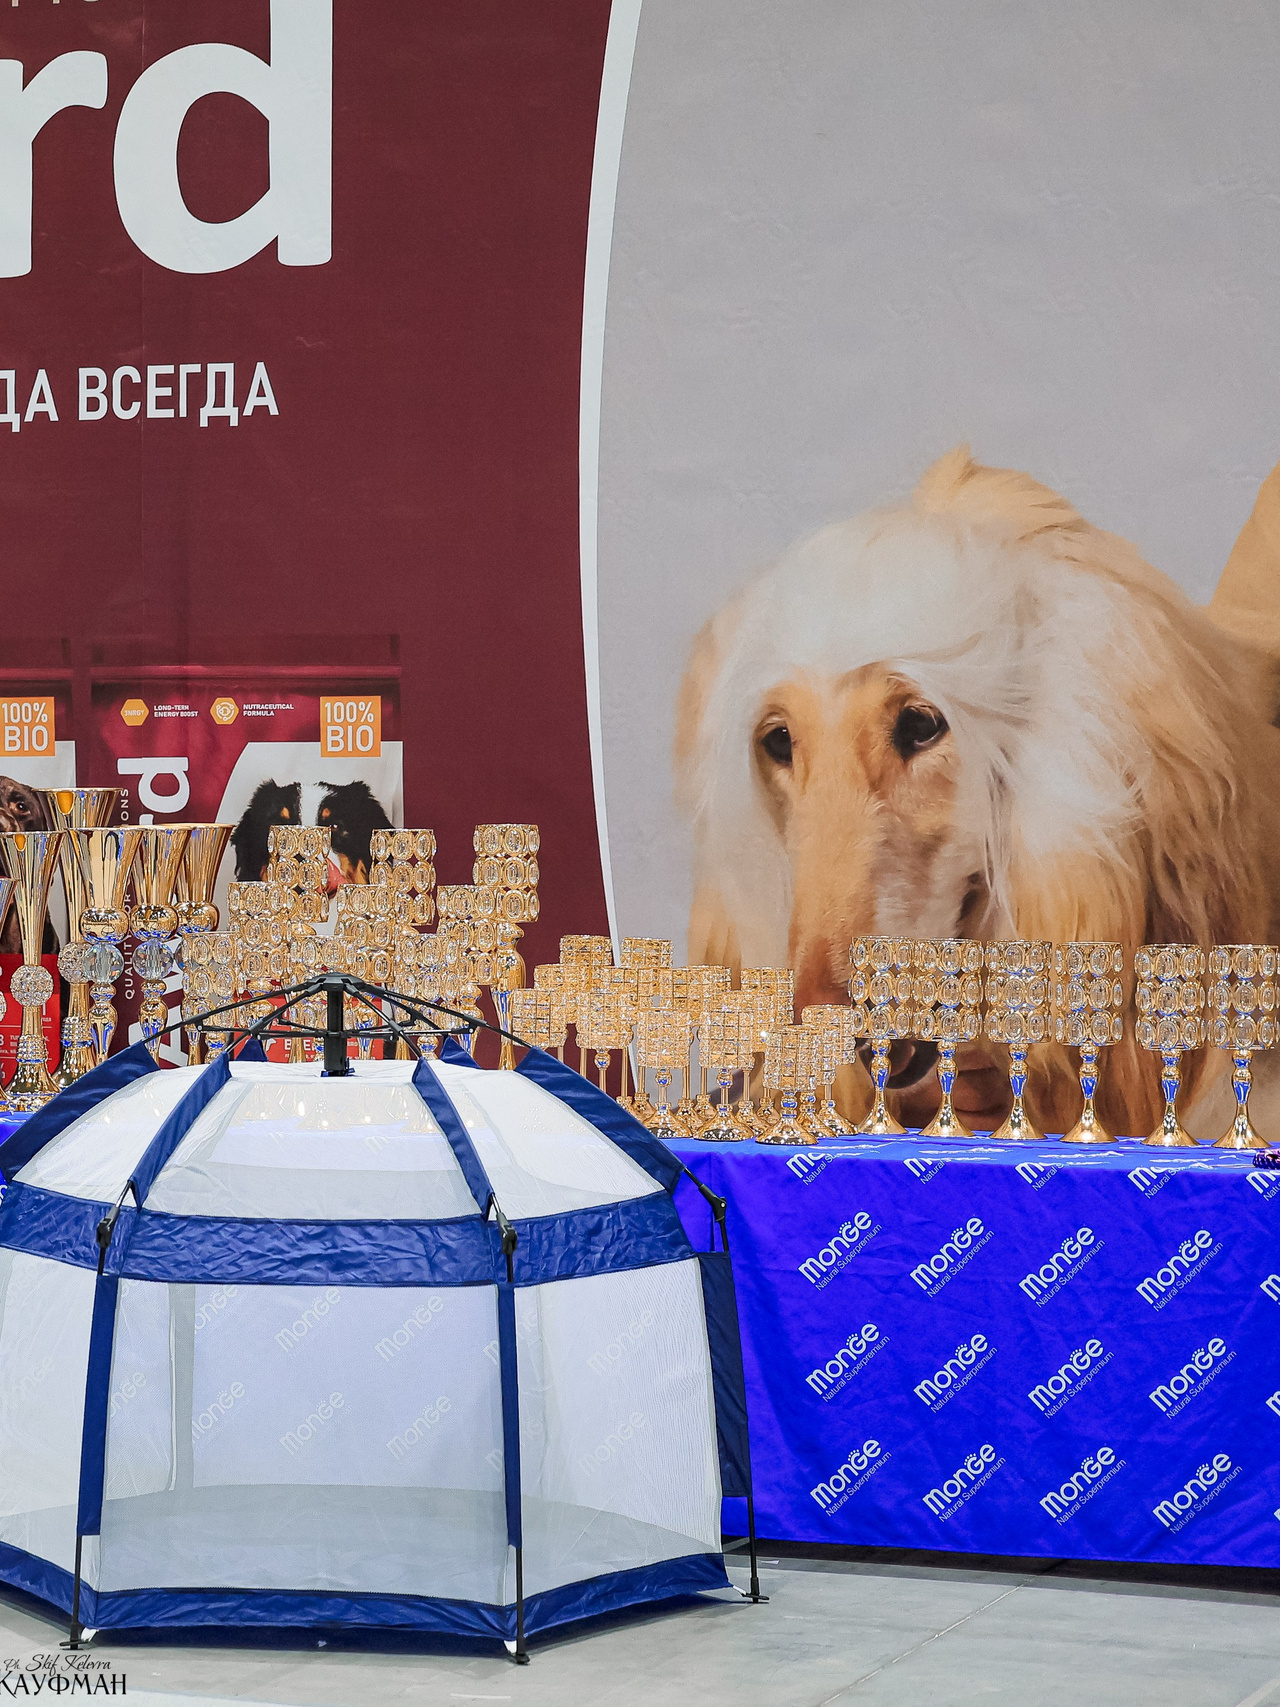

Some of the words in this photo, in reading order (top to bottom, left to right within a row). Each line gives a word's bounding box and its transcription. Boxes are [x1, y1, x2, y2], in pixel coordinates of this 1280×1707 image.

[78, 361, 280, 427] ВСЕГДА
[1, 702, 48, 724] 100%
[4, 725, 49, 752] BIO
[324, 701, 374, 724] 100%
[327, 726, 374, 752] BIO
[802, 1161, 826, 1186] Natural
[920, 1161, 945, 1184] Natural
[1032, 1167, 1057, 1191] Natural
[1145, 1174, 1170, 1199] Natural
[815, 1267, 839, 1292] Natural
[837, 1223, 882, 1269] Superpremium
[927, 1273, 951, 1298] Natural
[949, 1230, 994, 1275] Superpremium
[1035, 1283, 1061, 1308] Natural
[1059, 1239, 1106, 1286] Superpremium
[1153, 1287, 1179, 1312] Natural
[1176, 1241, 1223, 1289] Superpremium
[822, 1379, 846, 1403] Natural
[844, 1335, 890, 1381] Superpremium
[931, 1389, 955, 1413] Natural
[953, 1346, 998, 1391] Superpremium
[1044, 1394, 1070, 1419] Natural
[1067, 1351, 1115, 1398] Superpremium
[1166, 1394, 1191, 1419] Natural
[1189, 1350, 1237, 1398] Superpremium
[826, 1494, 849, 1517] Natural
[846, 1450, 892, 1496] Superpremium
[938, 1498, 964, 1523] Natural
[962, 1456, 1006, 1501] Superpremium
[1056, 1501, 1082, 1526] Natural
[1079, 1459, 1127, 1505] Superpremium
[1169, 1509, 1195, 1534] Natural
[1193, 1465, 1243, 1512] Superpremium
